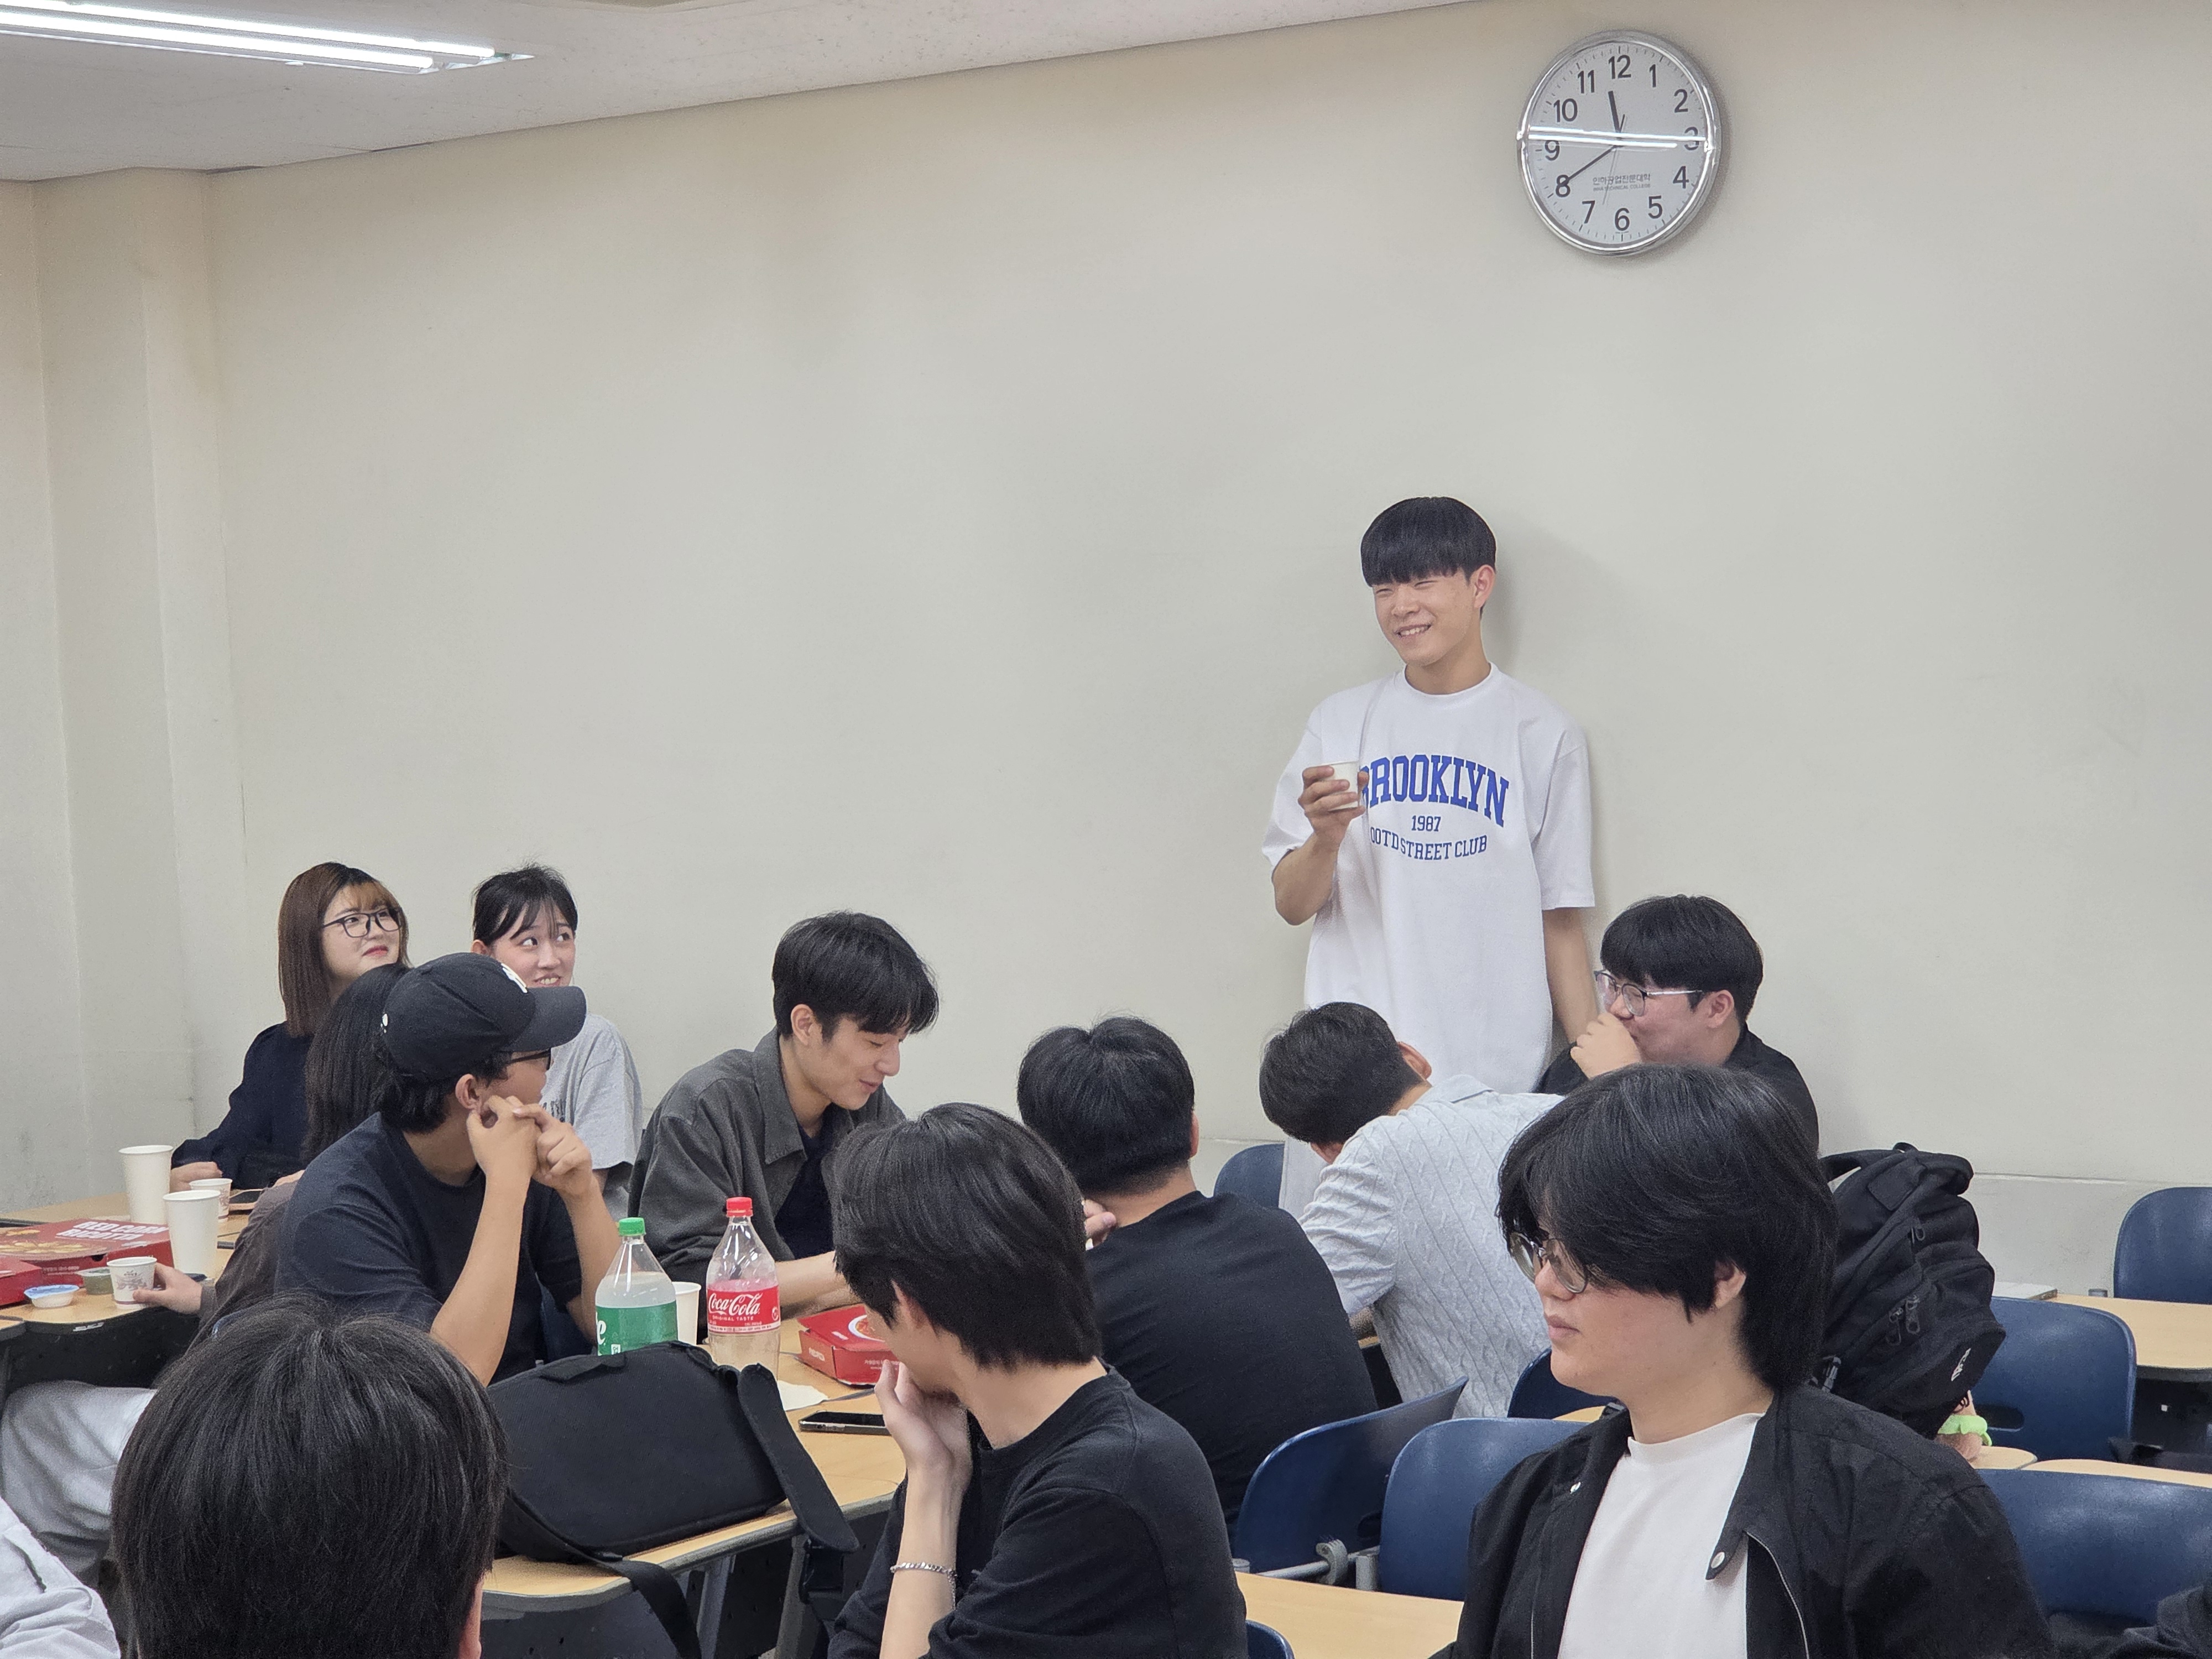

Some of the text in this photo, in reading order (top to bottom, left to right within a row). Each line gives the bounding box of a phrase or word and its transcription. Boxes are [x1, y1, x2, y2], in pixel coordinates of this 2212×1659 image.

[1608, 54, 1631, 79] 12
[1649, 64, 1657, 87] 1
[1578, 70, 1595, 94] 11
[1553, 98, 1578, 122] 10
[1673, 88, 1688, 113] 2
[1545, 139, 1560, 161] 9
[1684, 126, 1699, 150] 3
[1555, 174, 1571, 197] 8
[1672, 166, 1689, 189] 4
[1582, 200, 1595, 224] 7
[1615, 207, 1630, 231] 6
[1648, 195, 1662, 219] 5
[1411, 815, 1441, 832] 1987
[1400, 837, 1452, 860] STREET
[1454, 835, 1487, 857] CLUB
[708, 1292, 763, 1316] Coca-Cola
